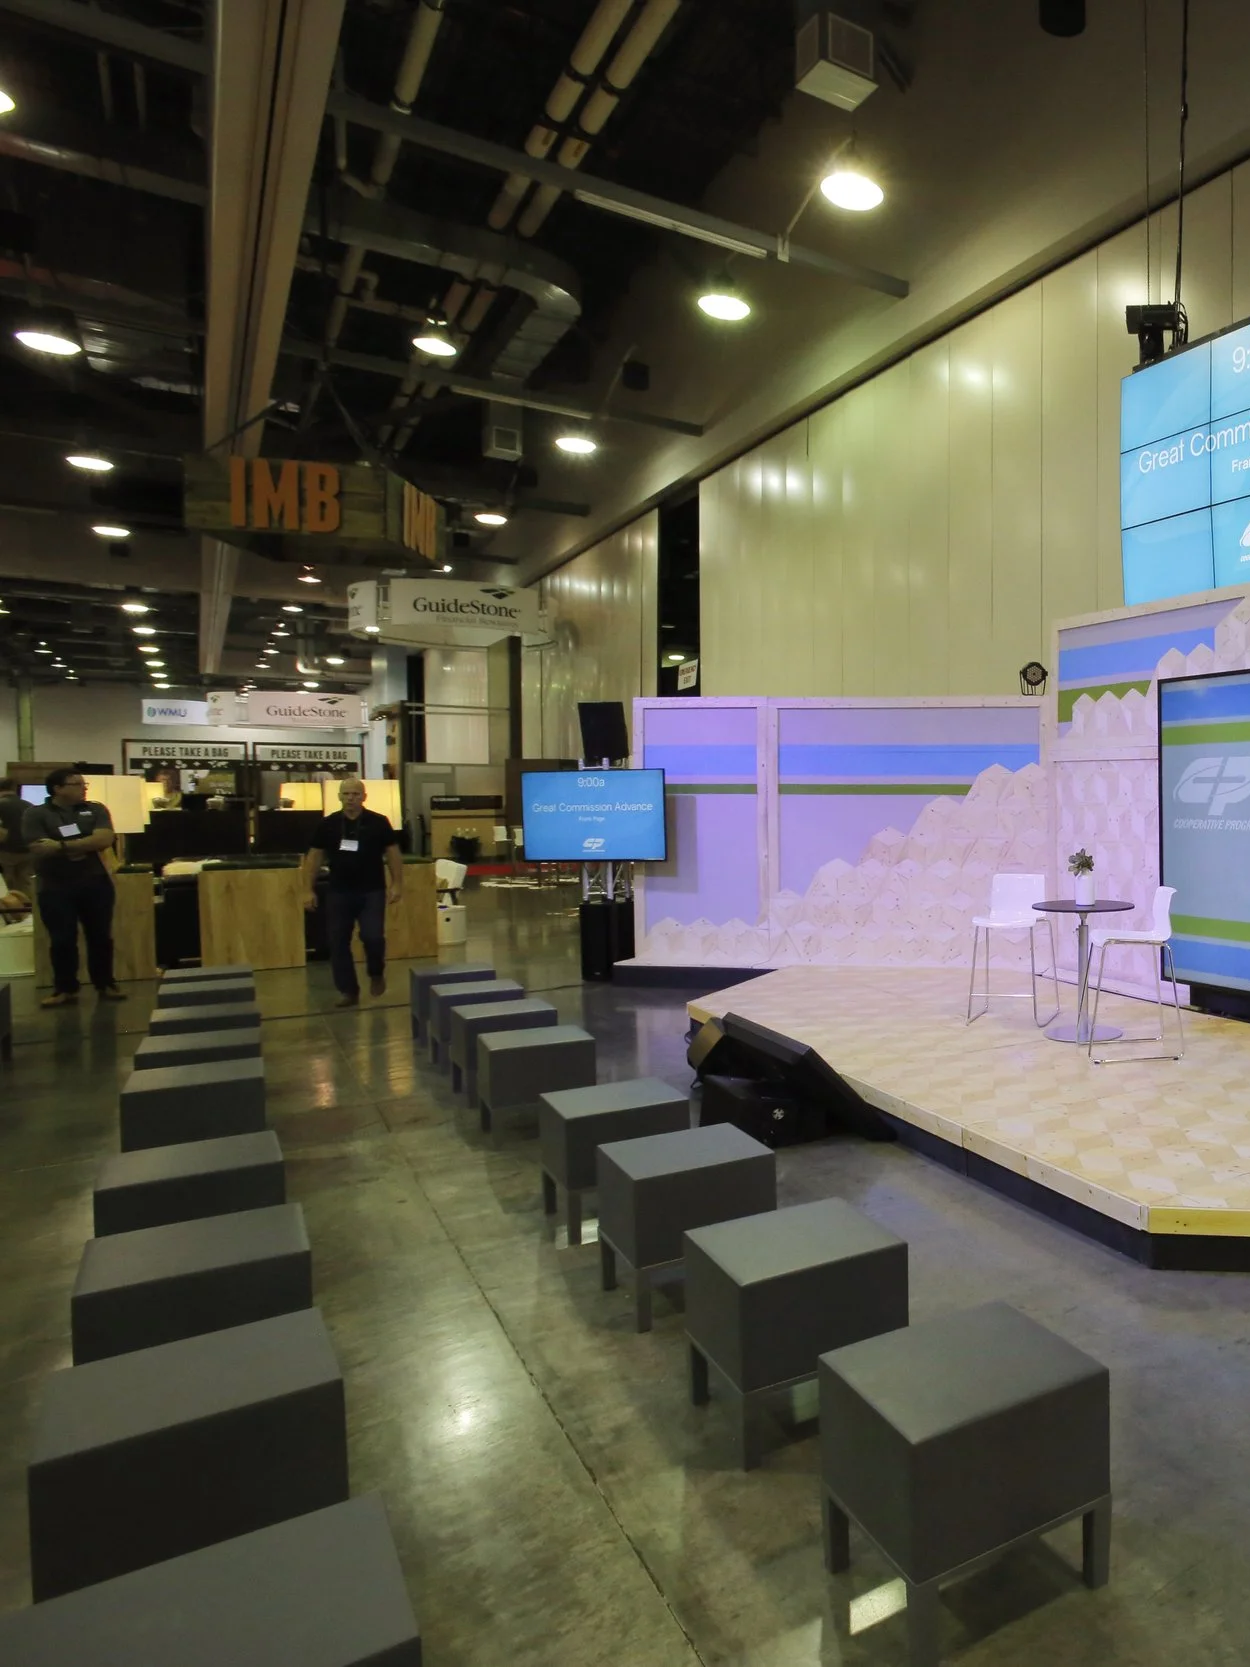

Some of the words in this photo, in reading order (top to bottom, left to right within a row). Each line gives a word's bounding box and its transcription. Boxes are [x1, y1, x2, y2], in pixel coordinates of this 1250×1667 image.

[1138, 440, 1184, 474] Great
[229, 455, 342, 533] IMB
[413, 597, 519, 619] GuideStone
[157, 707, 187, 718] WMU
[266, 705, 347, 718] GuideStone
[142, 746, 176, 757] PLEASE
[179, 747, 202, 757] TAKE
[204, 748, 210, 757] A
[212, 748, 229, 758] BAG
[271, 749, 301, 759] PLEASE
[303, 750, 324, 759] TAKE
[325, 751, 331, 759] A
[333, 751, 348, 760] BAG
[577, 776, 605, 788] 9:00a
[532, 803, 556, 812] Great
[558, 803, 612, 812] Commission
[615, 801, 653, 811] Advance
[1174, 818, 1224, 829] COOPERATIVE
